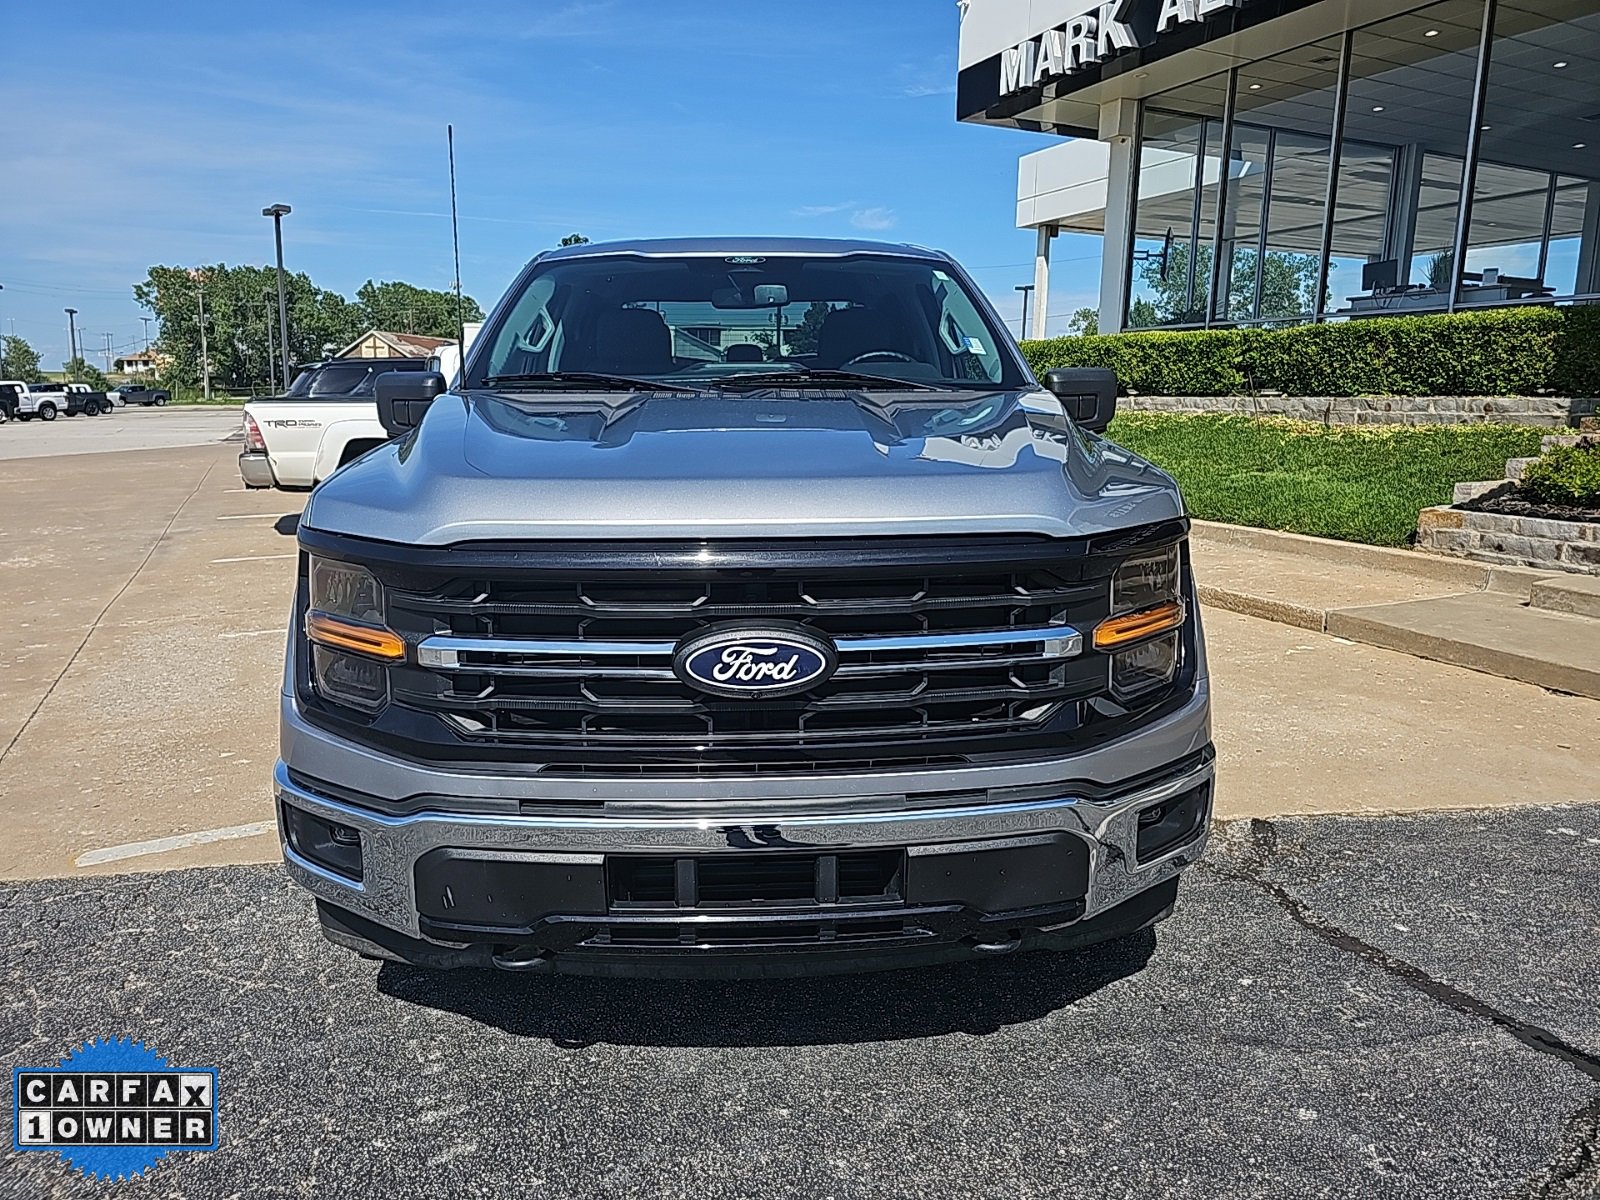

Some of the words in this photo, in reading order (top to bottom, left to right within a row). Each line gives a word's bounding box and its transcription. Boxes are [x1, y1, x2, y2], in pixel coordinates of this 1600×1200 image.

[1000, 0, 1140, 97] MARK
[263, 420, 297, 428] TRD
[712, 646, 799, 681] Ford
